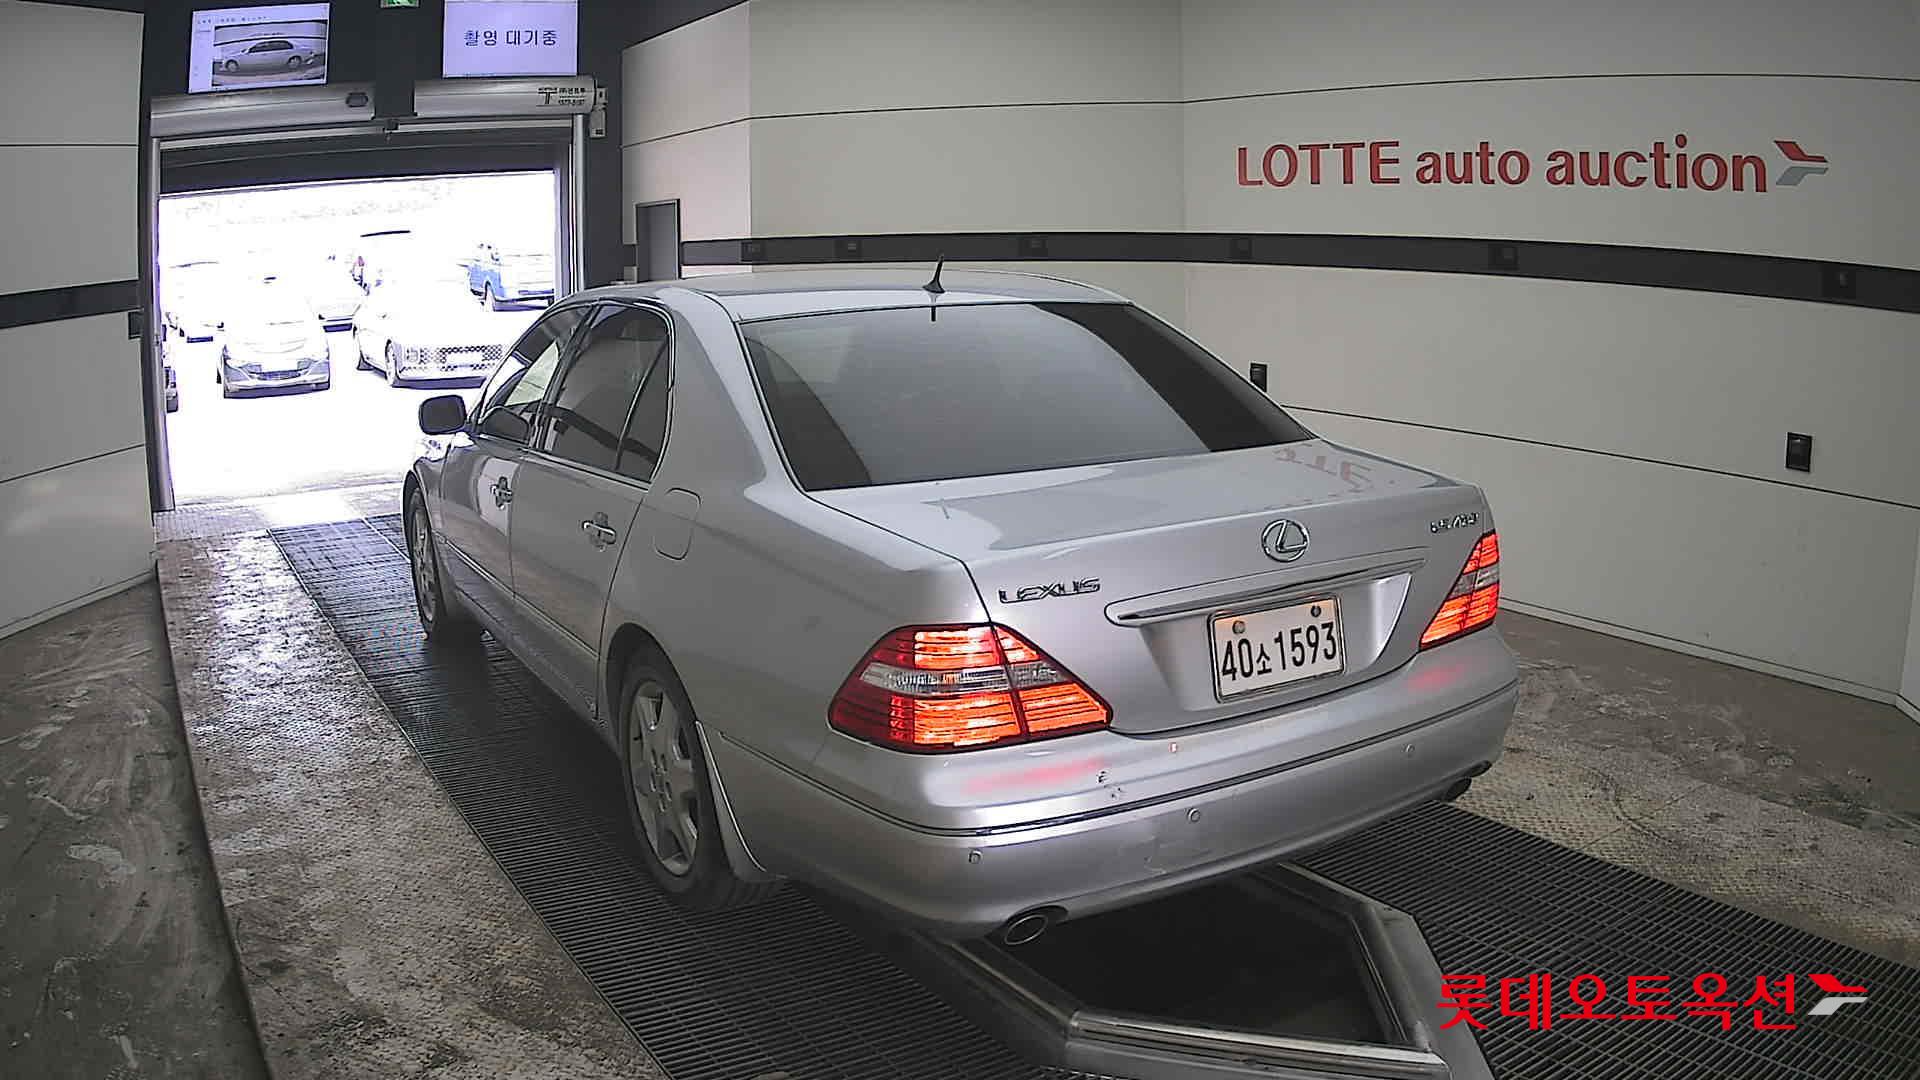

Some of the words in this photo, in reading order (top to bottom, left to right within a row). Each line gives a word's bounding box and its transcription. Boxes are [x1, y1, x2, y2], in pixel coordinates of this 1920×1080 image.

[506, 29, 557, 47] 대기중
[1238, 142, 1399, 188] LOTTE
[1416, 141, 1531, 186] auto
[1545, 134, 1768, 193] auction
[998, 578, 1101, 605] LEXUS
[1221, 621, 1338, 681] 40소1593
